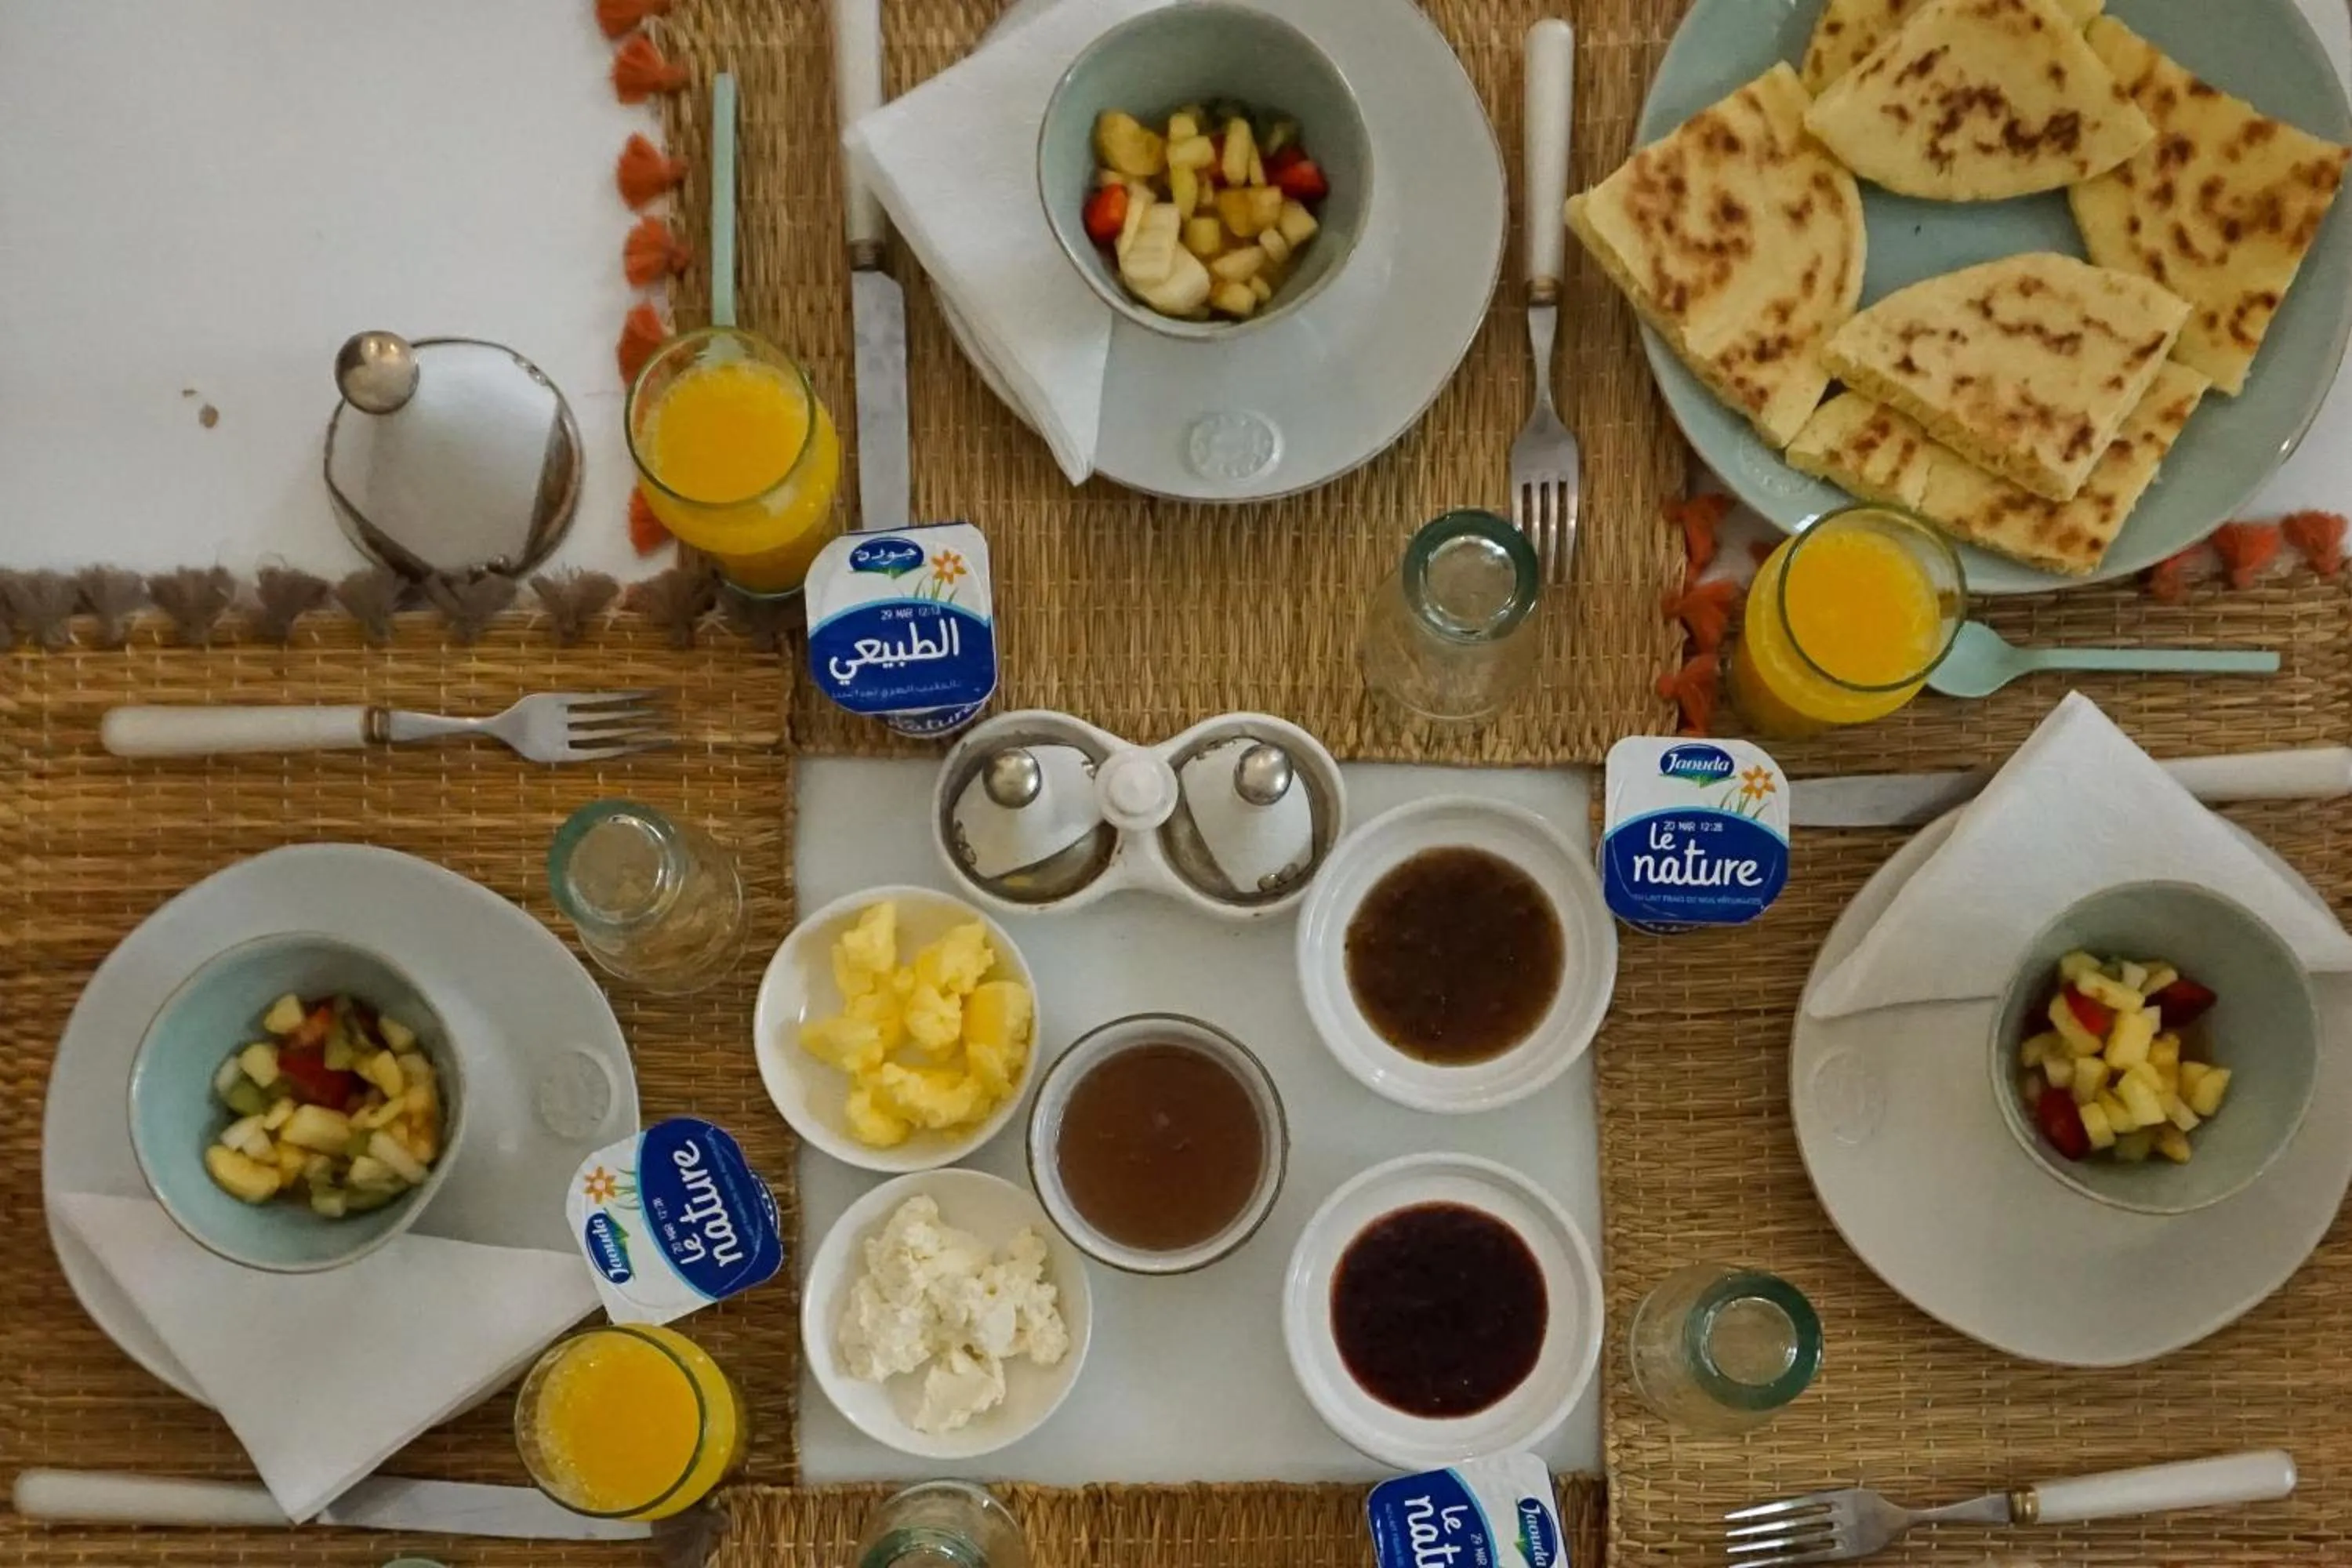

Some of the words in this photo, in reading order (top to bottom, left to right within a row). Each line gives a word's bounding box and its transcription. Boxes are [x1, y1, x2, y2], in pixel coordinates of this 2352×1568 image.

[829, 617, 960, 685] الطبيعي
[1668, 753, 1730, 773] Jaouda
[1650, 822, 1676, 851] le
[1633, 838, 1763, 887] nature
[673, 1139, 743, 1268] nature
[592, 1218, 630, 1278] Jaouda
[680, 1232, 706, 1264] le
[1440, 1504, 1468, 1534] le
[1519, 1504, 1550, 1567] Jaouda
